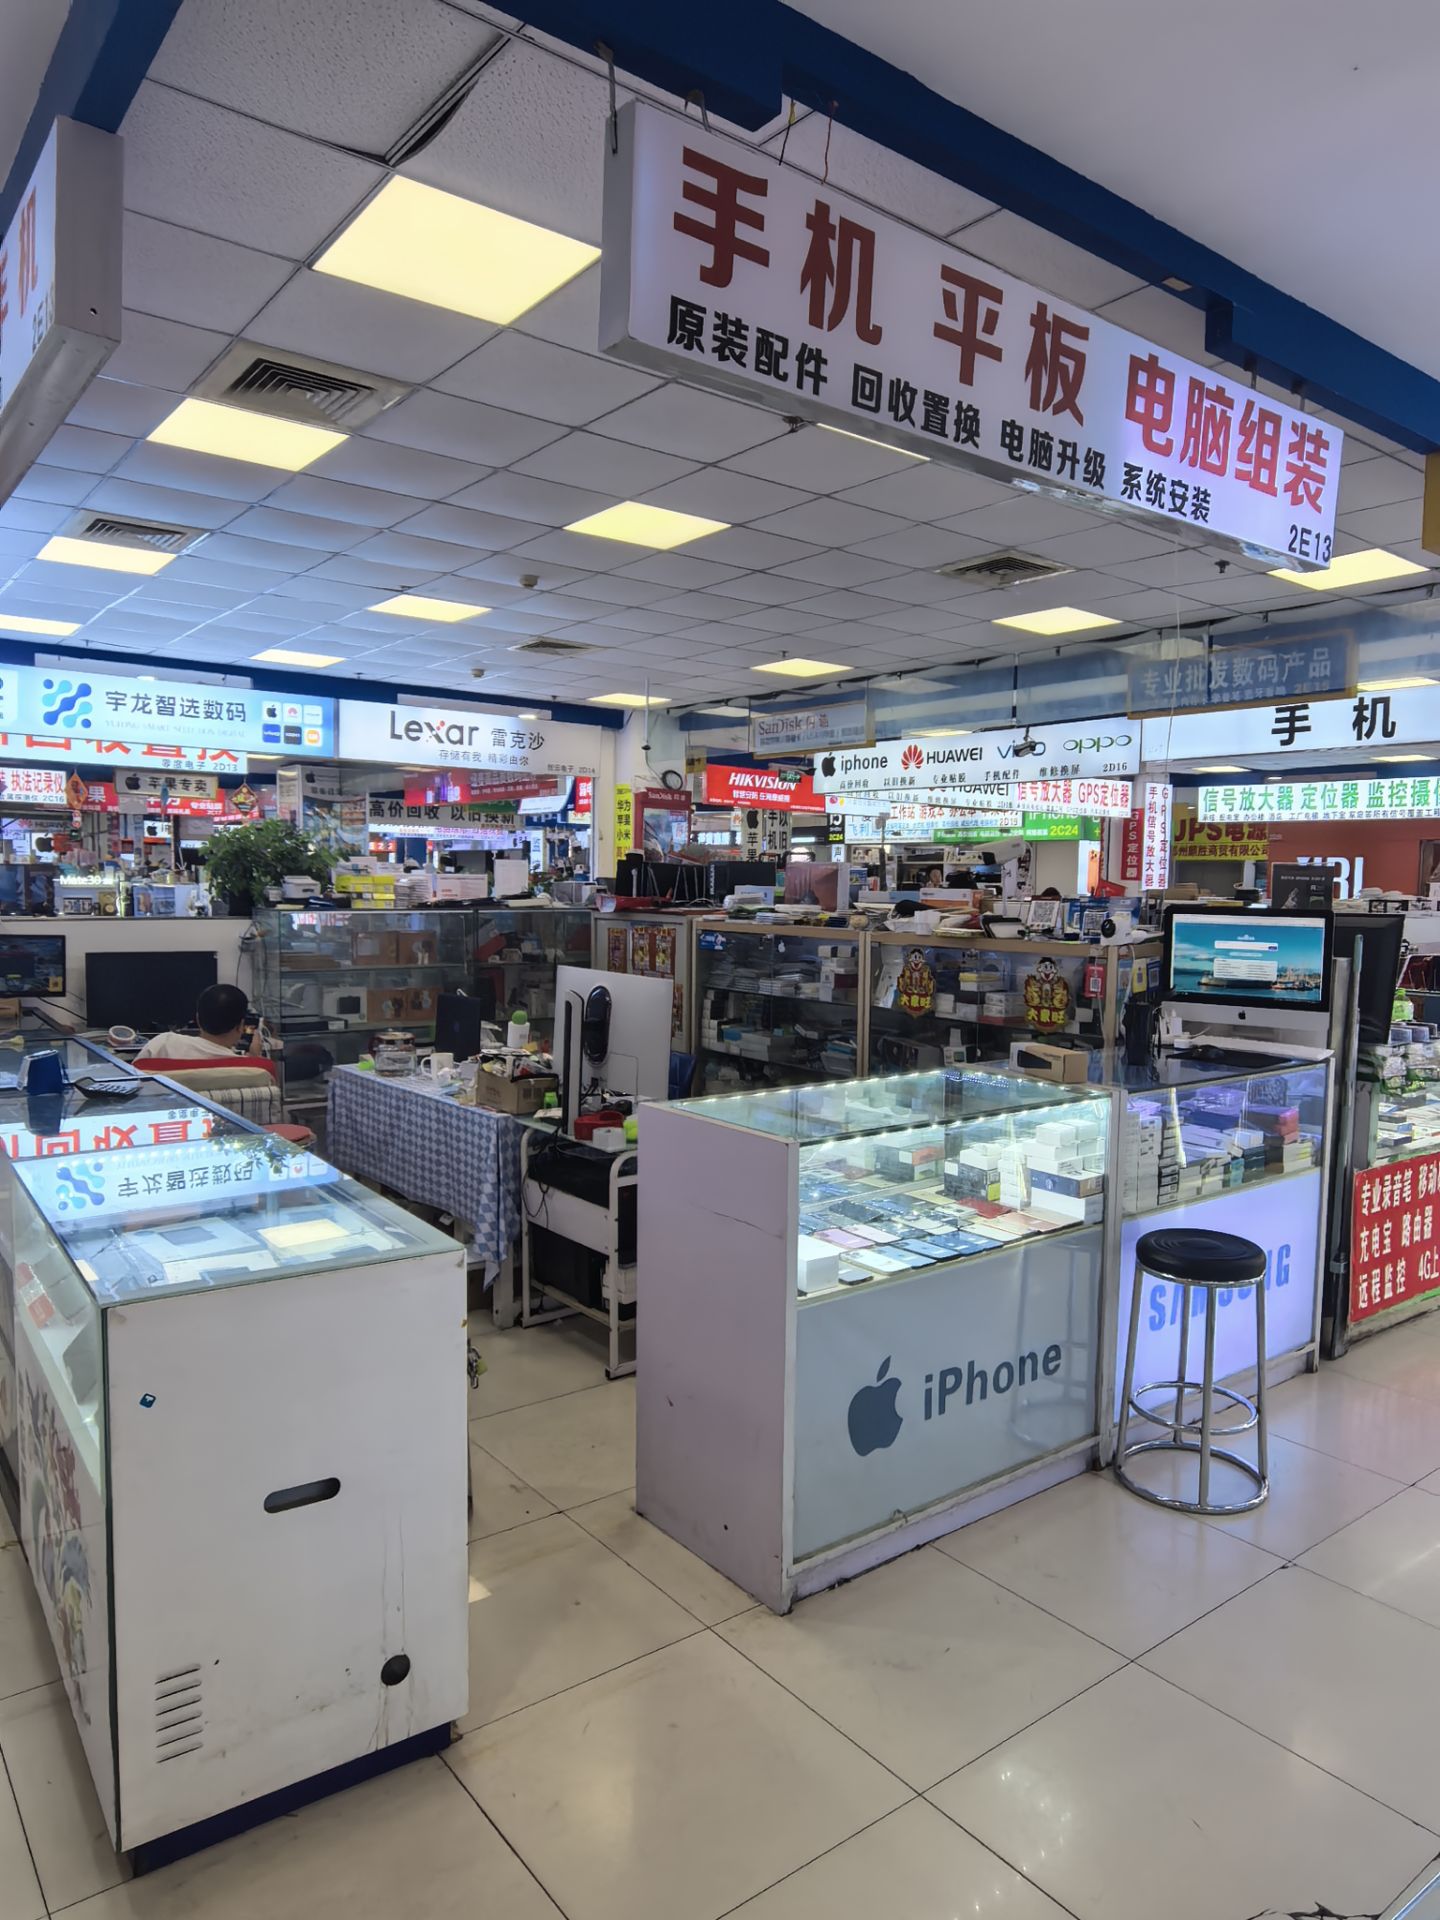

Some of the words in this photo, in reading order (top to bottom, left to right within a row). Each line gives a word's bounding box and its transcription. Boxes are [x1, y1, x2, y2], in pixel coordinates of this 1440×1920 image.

[667, 294, 829, 397] 原装配件
[851, 362, 981, 449] 回收置换
[1000, 418, 1106, 491] 电脑升级
[1120, 461, 1212, 524] 系统安装
[1124, 352, 1330, 515] 电脑组装
[1288, 524, 1332, 563] 2E13
[1141, 647, 1331, 697] 专业批发数码产品
[105, 689, 247, 723] 宇龙智选数码
[390, 710, 480, 747] Lexar
[490, 727, 546, 750] 雷克沙
[758, 716, 803, 736] SanDisk
[213, 762, 238, 772] 2D13
[438, 748, 482, 762] 存储有我
[840, 754, 888, 775] iphone
[926, 747, 983, 765] HUAWEI
[1102, 762, 1128, 772] 2D16
[728, 772, 797, 792] HIKVISION
[839, 778, 870, 790] 高价回收
[883, 776, 916, 787] 以旧换新
[933, 772, 967, 784] 专业贴膜
[984, 769, 1020, 781] 手机配件
[1039, 764, 1081, 777] 维修换屏
[1018, 780, 1072, 804] 信号放大器
[1078, 782, 1129, 808] GPS定位器
[1203, 786, 1294, 813] 信号放大器
[1300, 782, 1360, 811] 定位器
[368, 799, 440, 821] 高价回收
[1049, 824, 1079, 836] 2C24
[1145, 786, 1159, 887] 手机信号放大器
[1360, 1168, 1413, 1217] 专业录音笔
[1418, 1159, 1440, 1200] 移动
[1359, 1218, 1393, 1264] 充电宝
[1401, 1204, 1434, 1248] 路由器
[1358, 1256, 1406, 1310] 远程监控
[924, 1344, 1062, 1421] iPhone
